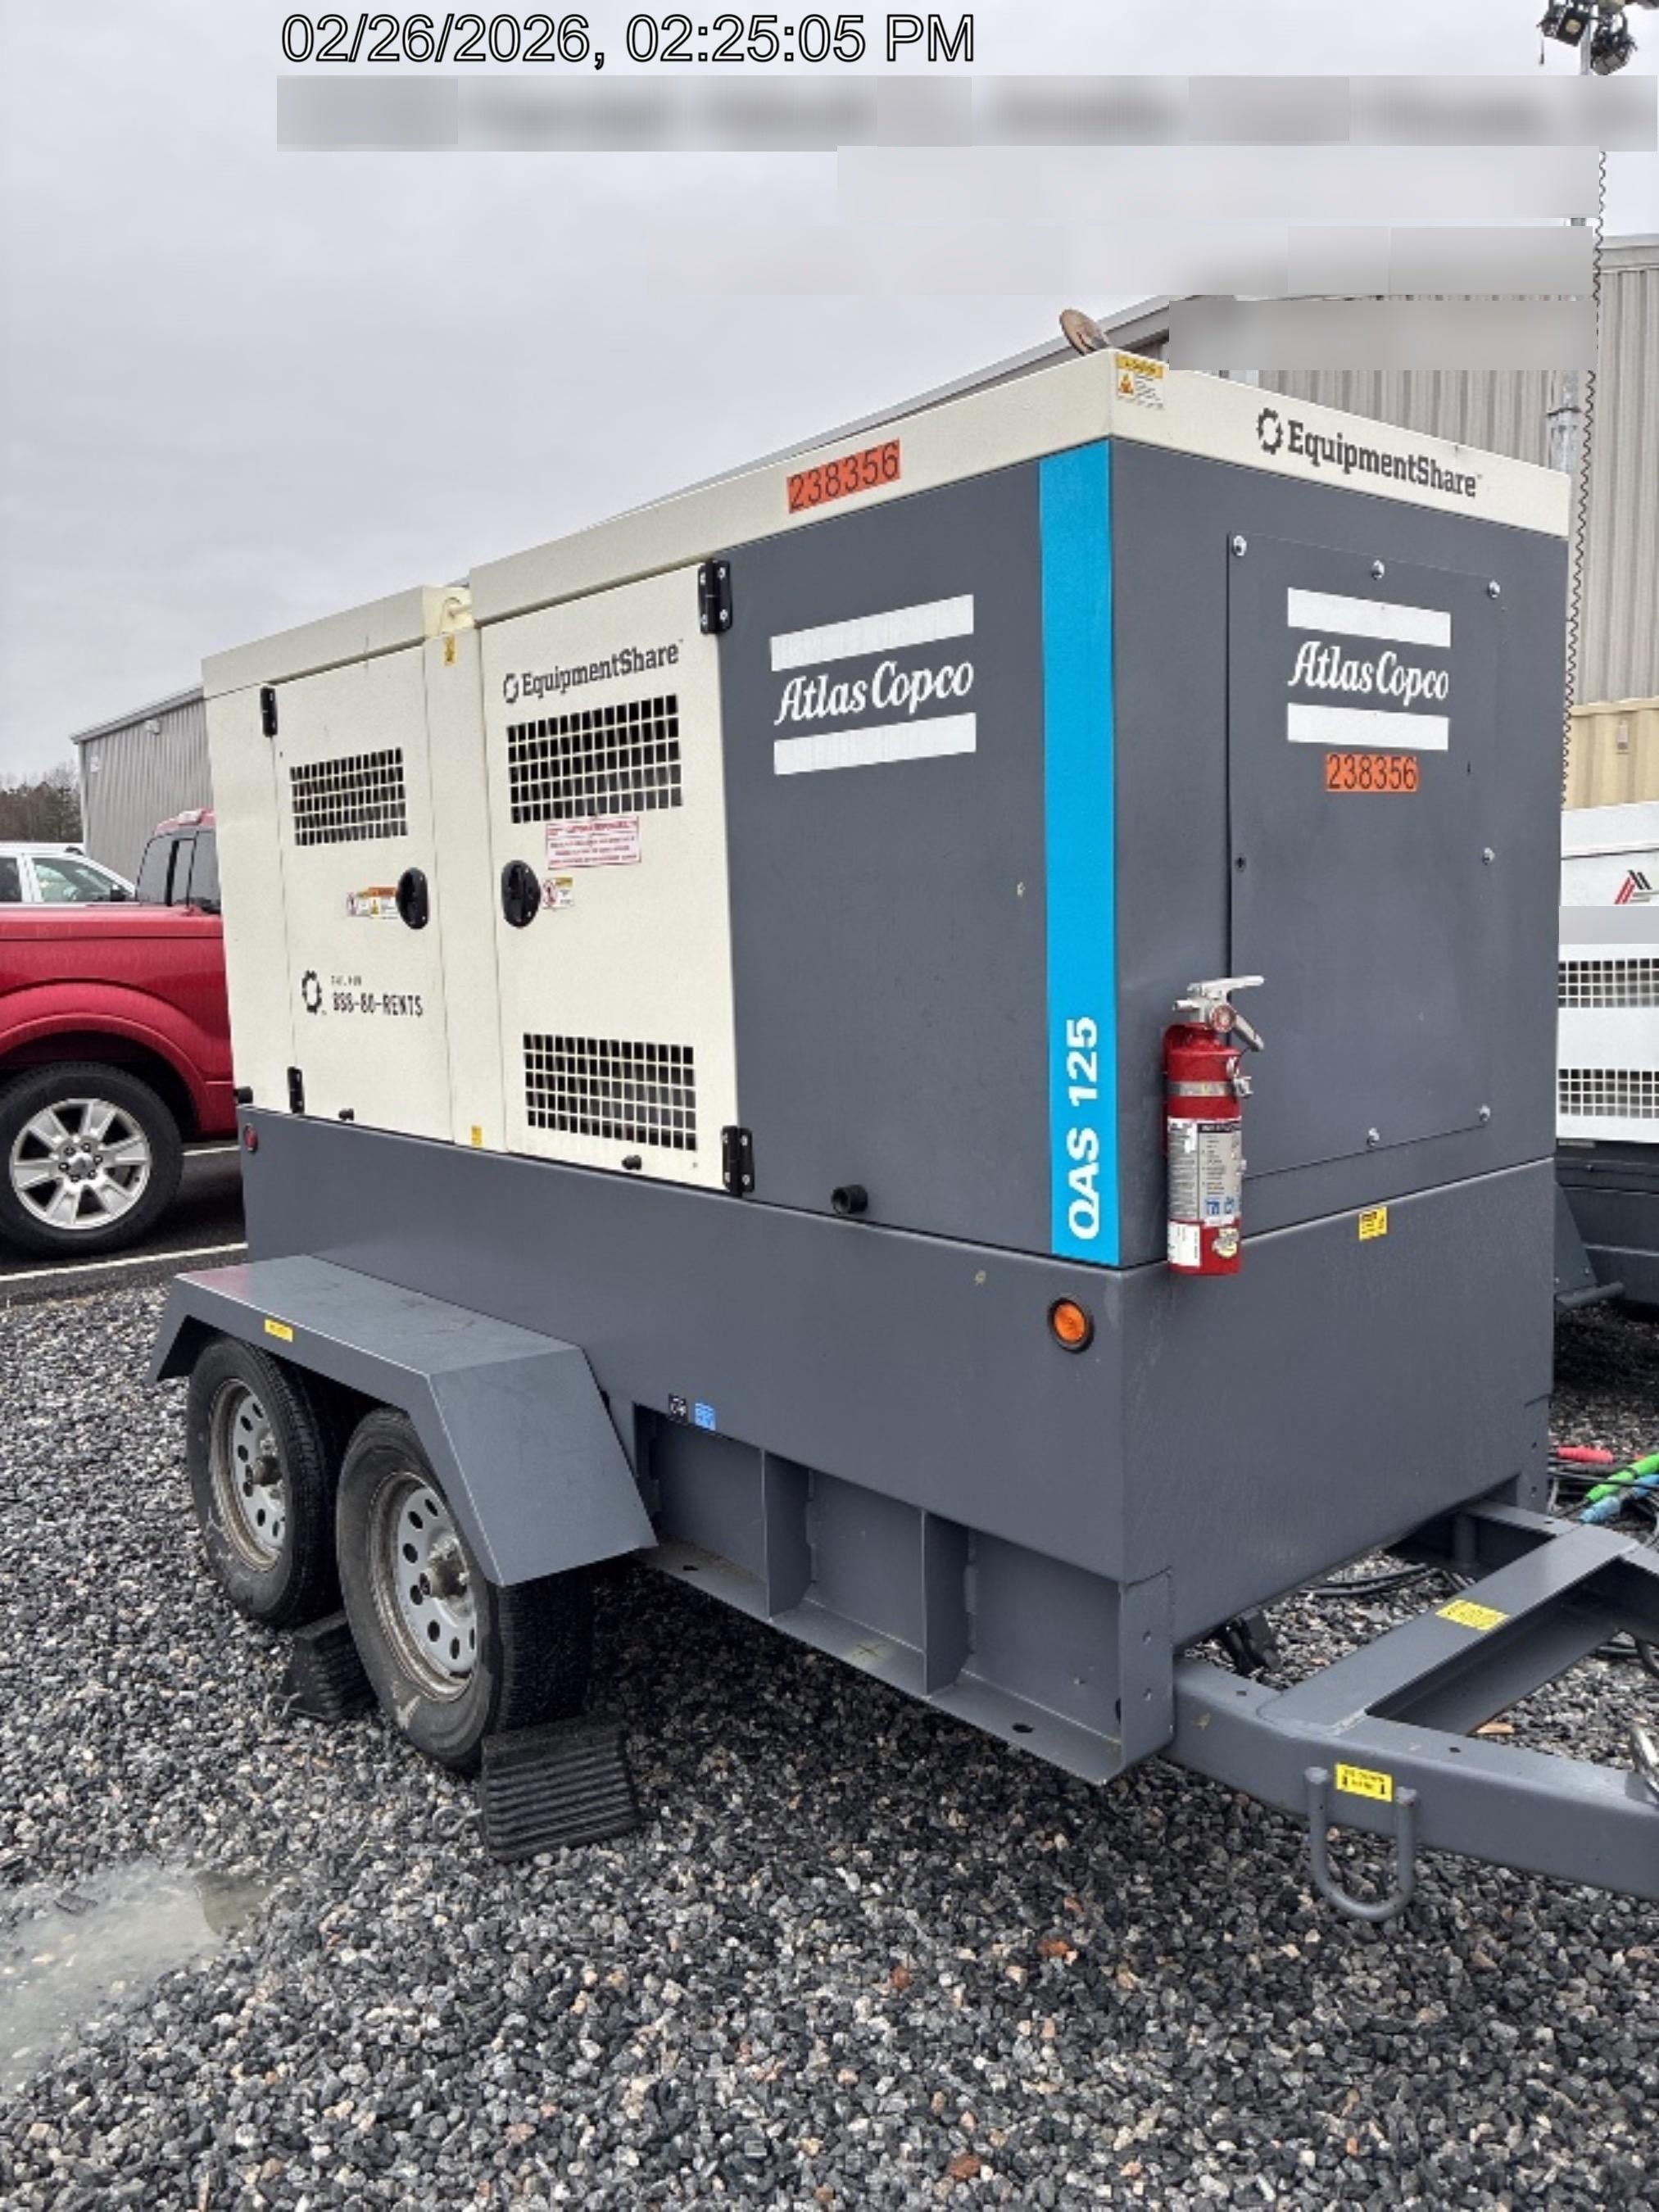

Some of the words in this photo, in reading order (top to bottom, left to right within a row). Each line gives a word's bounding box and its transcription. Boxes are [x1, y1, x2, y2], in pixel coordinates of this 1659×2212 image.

[790, 442, 900, 510] 238356
[1287, 419, 1476, 497] EquipmentShare
[521, 643, 679, 698] EquipmentShare
[773, 674, 868, 725] Atlas
[872, 660, 975, 714] Copco
[1288, 640, 1374, 693] Atlas
[1376, 650, 1449, 705] Copco
[1326, 754, 1418, 791] 238356
[1066, 1016, 1099, 1108] 125
[1066, 1127, 1100, 1240] QAS
